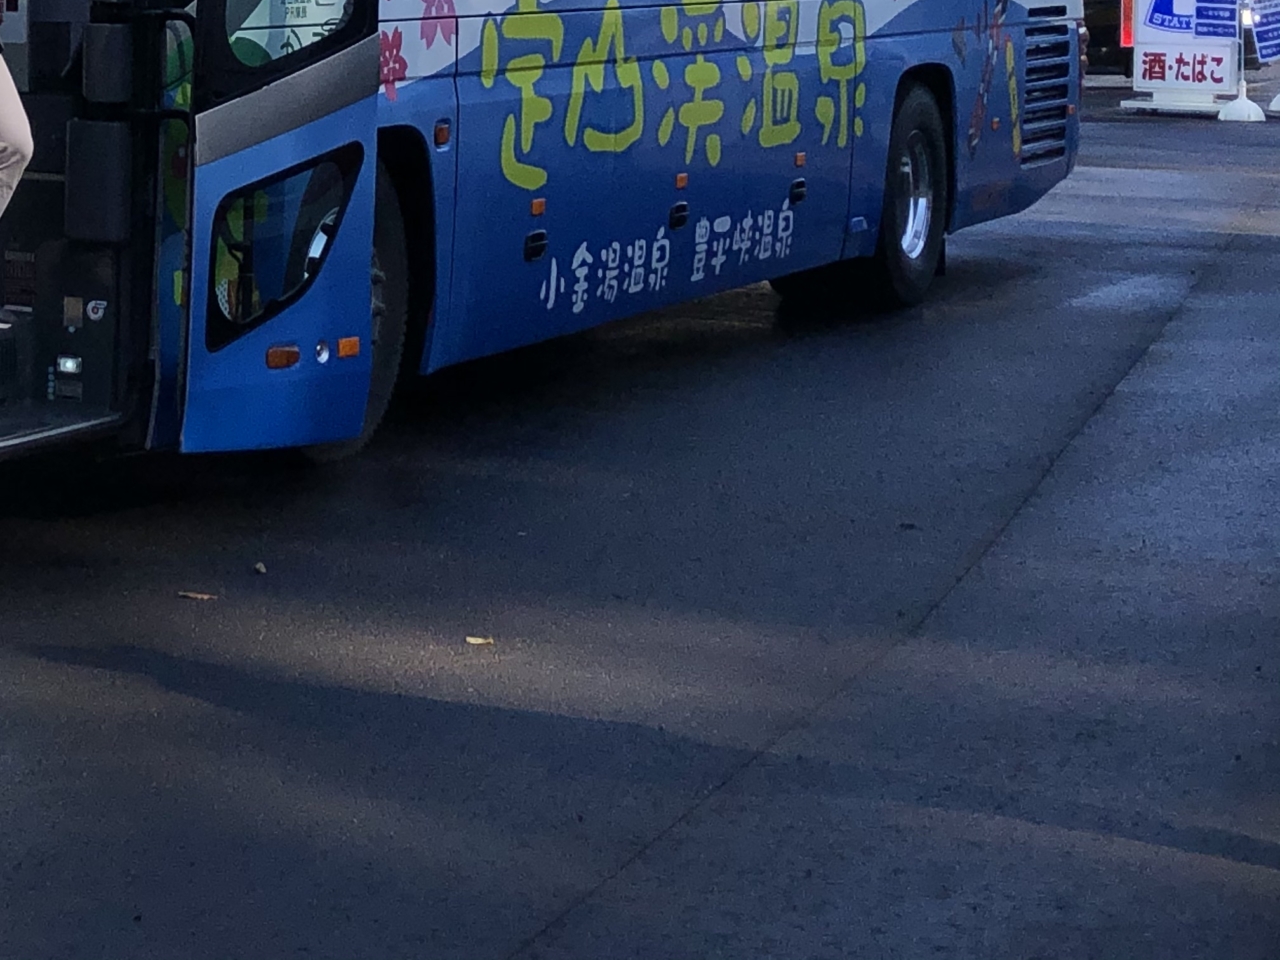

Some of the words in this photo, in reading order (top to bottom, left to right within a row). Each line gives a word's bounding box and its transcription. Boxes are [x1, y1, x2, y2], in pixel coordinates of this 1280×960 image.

[1152, 14, 1195, 28] STAT
[540, 227, 670, 313] 小金湯温泉
